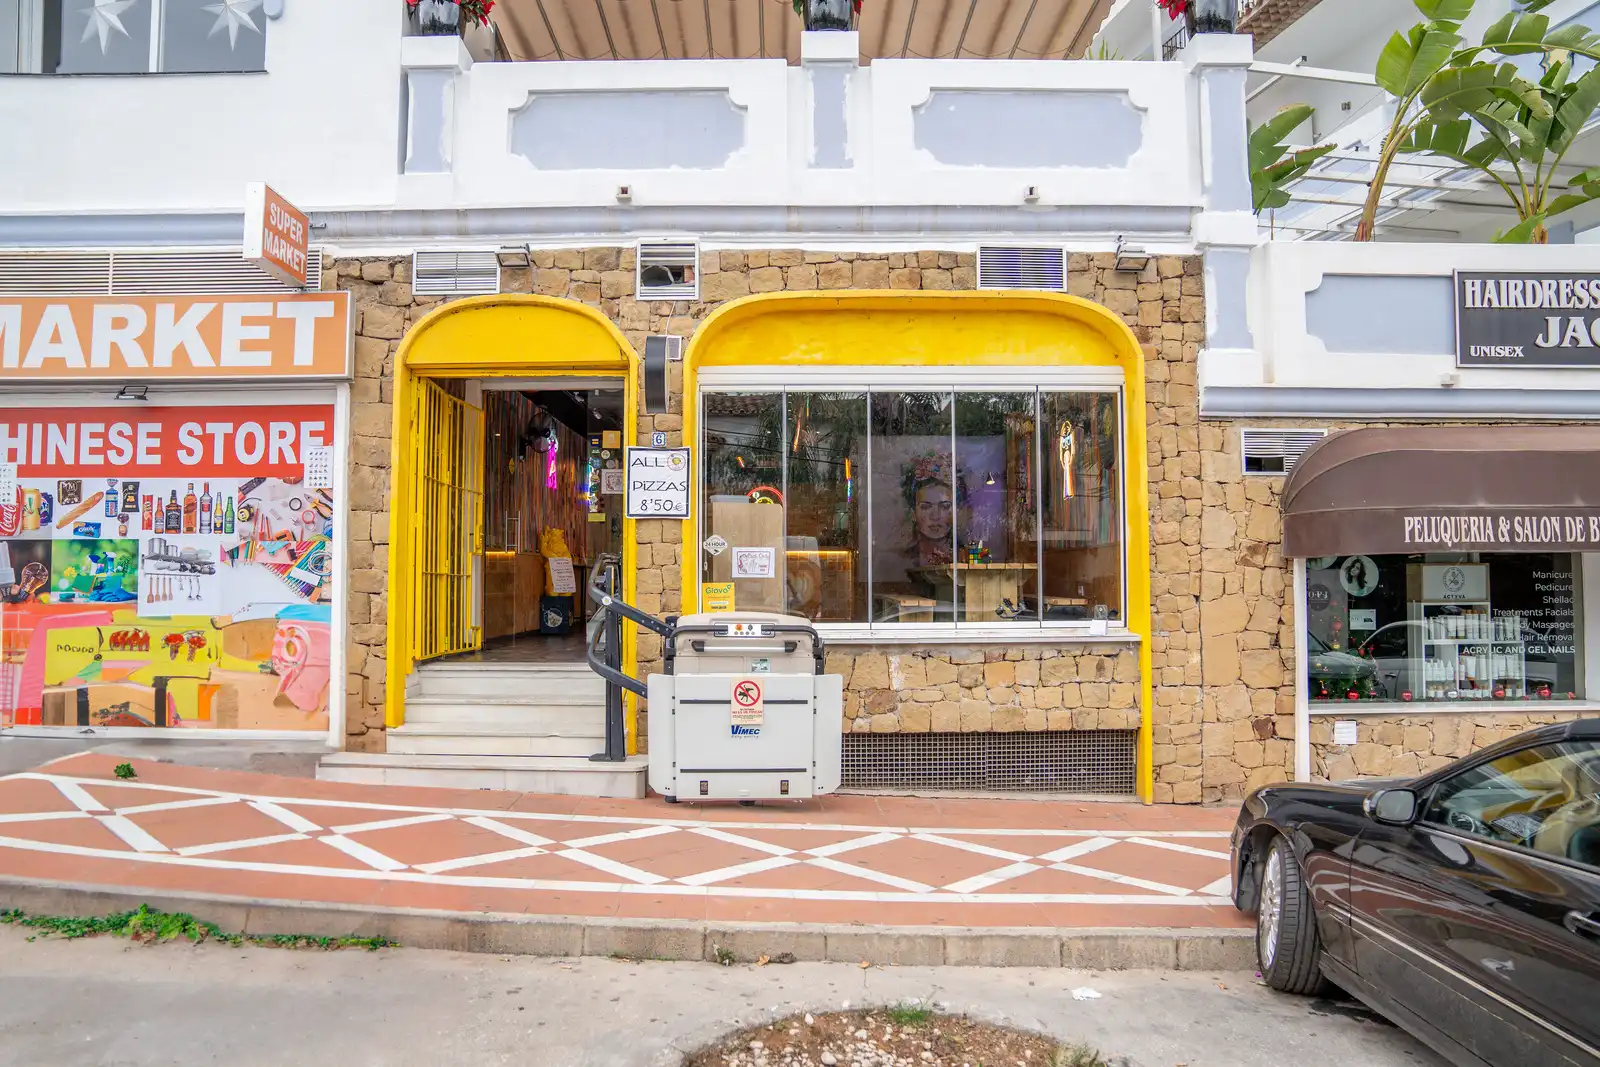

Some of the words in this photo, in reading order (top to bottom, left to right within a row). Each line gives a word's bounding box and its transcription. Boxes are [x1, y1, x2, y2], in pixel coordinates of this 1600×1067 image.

[269, 202, 303, 245] SUPER
[264, 227, 306, 275] MARKET
[1469, 345, 1524, 357] UNISEX
[177, 420, 326, 465] STORE
[655, 434, 663, 445] 6
[631, 456, 665, 468] ALL
[1404, 516, 1495, 548] PELUQUERIA
[1498, 516, 1511, 543] &
[1514, 516, 1561, 543] SALON
[1564, 516, 1587, 543] DE
[1588, 516, 1600, 543] B
[1532, 570, 1573, 579] Manicure
[705, 584, 732, 595] Glovo
[1535, 583, 1573, 592] Pedicure
[1542, 595, 1575, 604] Shellac
[1492, 608, 1543, 617] Treatments
[1545, 608, 1575, 617] Facials
[1532, 621, 1575, 630] Massages
[1504, 646, 1526, 654] AND
[1528, 646, 1546, 654] GEL
[1548, 645, 1576, 654] NAILS
